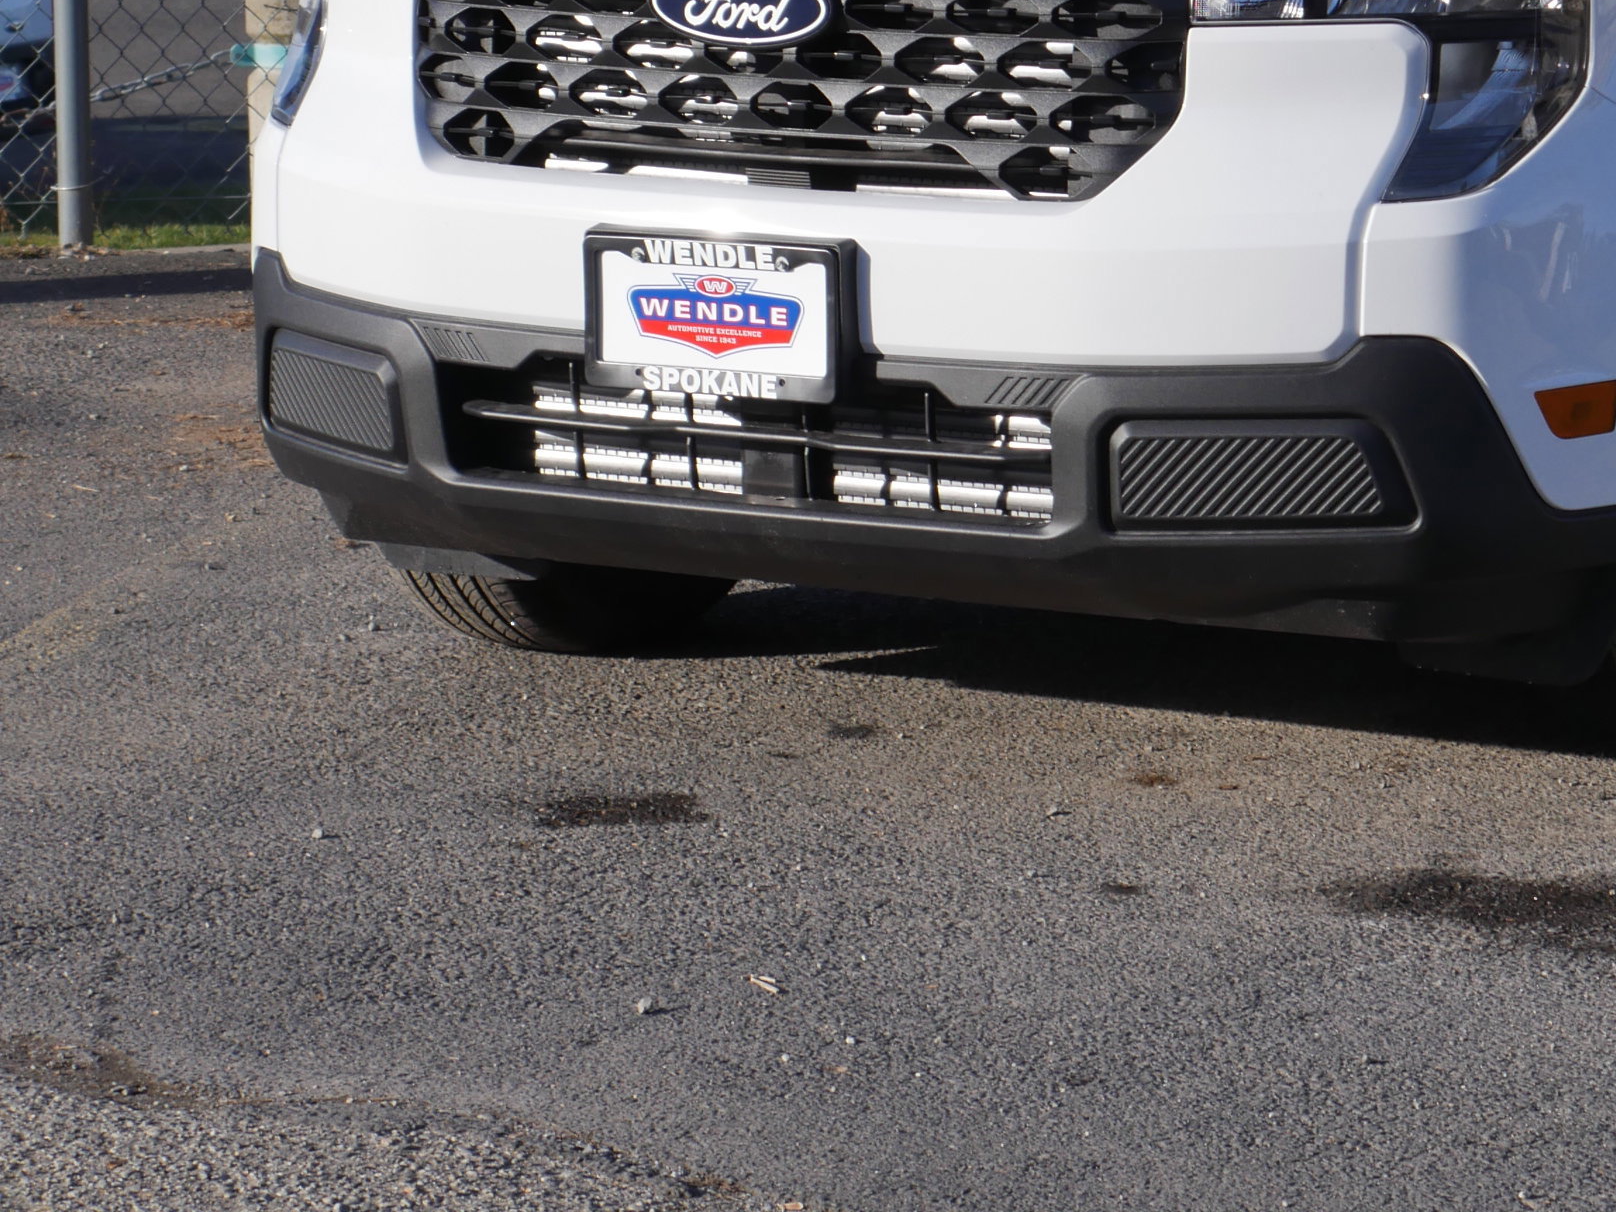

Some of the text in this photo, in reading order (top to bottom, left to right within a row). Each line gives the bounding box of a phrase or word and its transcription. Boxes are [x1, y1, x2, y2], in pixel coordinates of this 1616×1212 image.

[643, 239, 775, 271] WENDLE
[640, 297, 788, 327] WENDLE
[667, 325, 762, 338] AUTOMOTIVE EXCELLENCE
[695, 335, 717, 343] SINCE
[642, 366, 777, 399] SPOKANE
